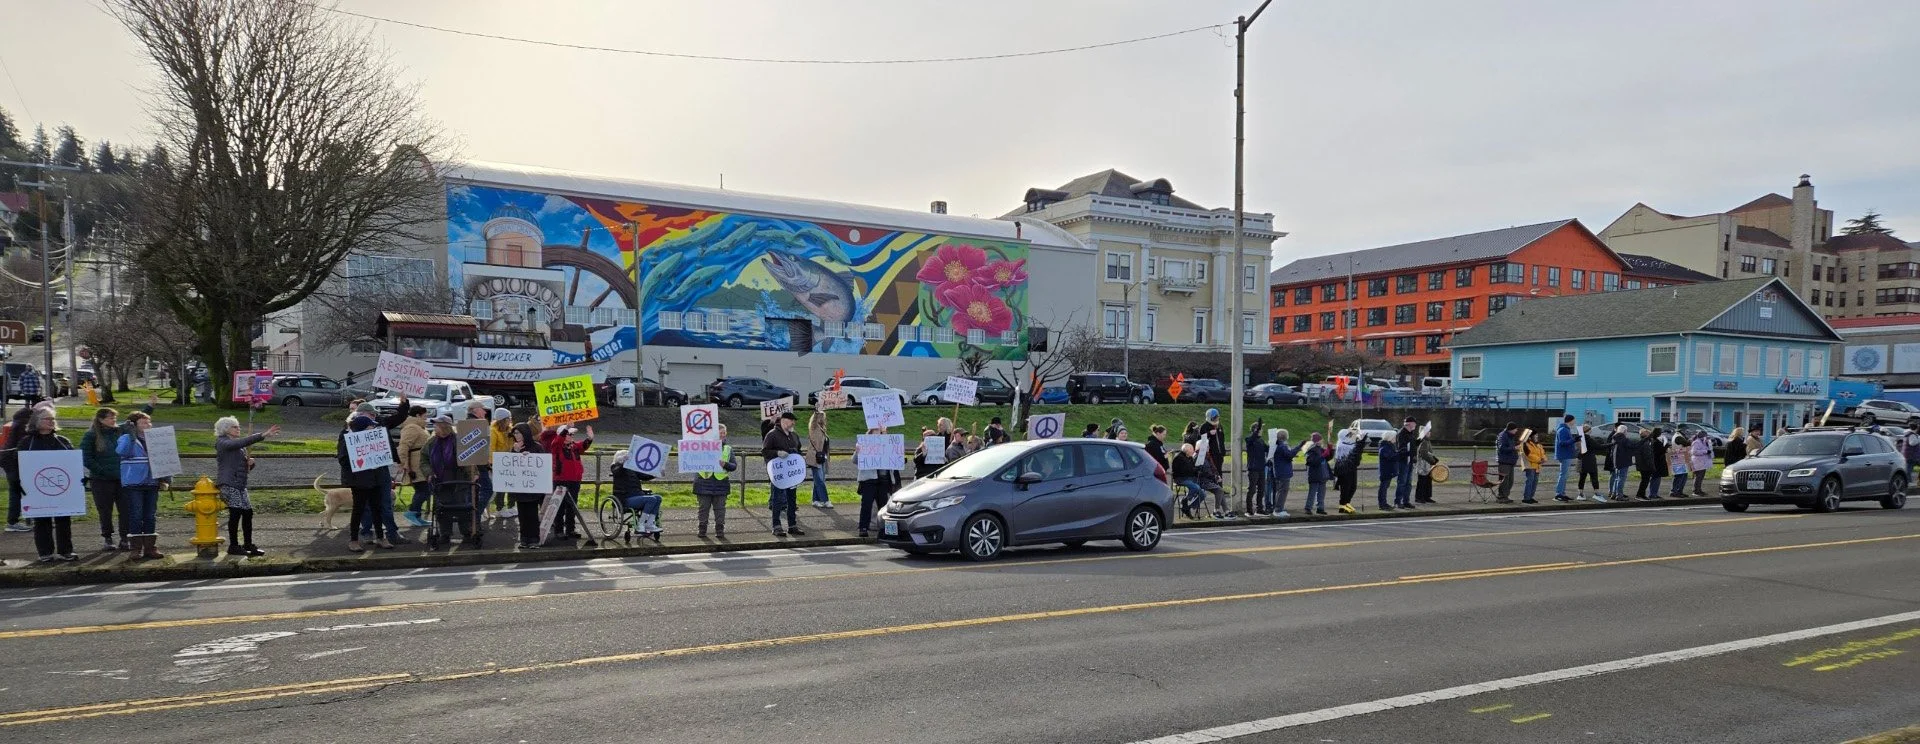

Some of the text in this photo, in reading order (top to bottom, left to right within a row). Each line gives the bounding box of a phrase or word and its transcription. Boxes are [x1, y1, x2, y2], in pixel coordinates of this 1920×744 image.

[0, 325, 18, 339] Dr
[476, 351, 532, 362] BOWPICKER
[576, 339, 623, 362] onger
[379, 359, 429, 379] RESISTING
[377, 376, 424, 395] ASSISTING
[548, 380, 583, 393] STAND
[544, 389, 587, 404] AGAINST
[546, 400, 590, 415] CRUELTY
[554, 409, 593, 424] MURDER
[365, 429, 384, 441] HERE
[461, 434, 473, 444] STOP
[356, 440, 388, 457] BECAUSE
[459, 439, 486, 460] ABDUCTIONS
[680, 442, 720, 451] HONK
[501, 455, 544, 468] GREED
[772, 459, 797, 470] ICE OUT
[499, 469, 538, 477] WILL KILL
[38, 474, 65, 488] ICE
[522, 480, 535, 488] US
